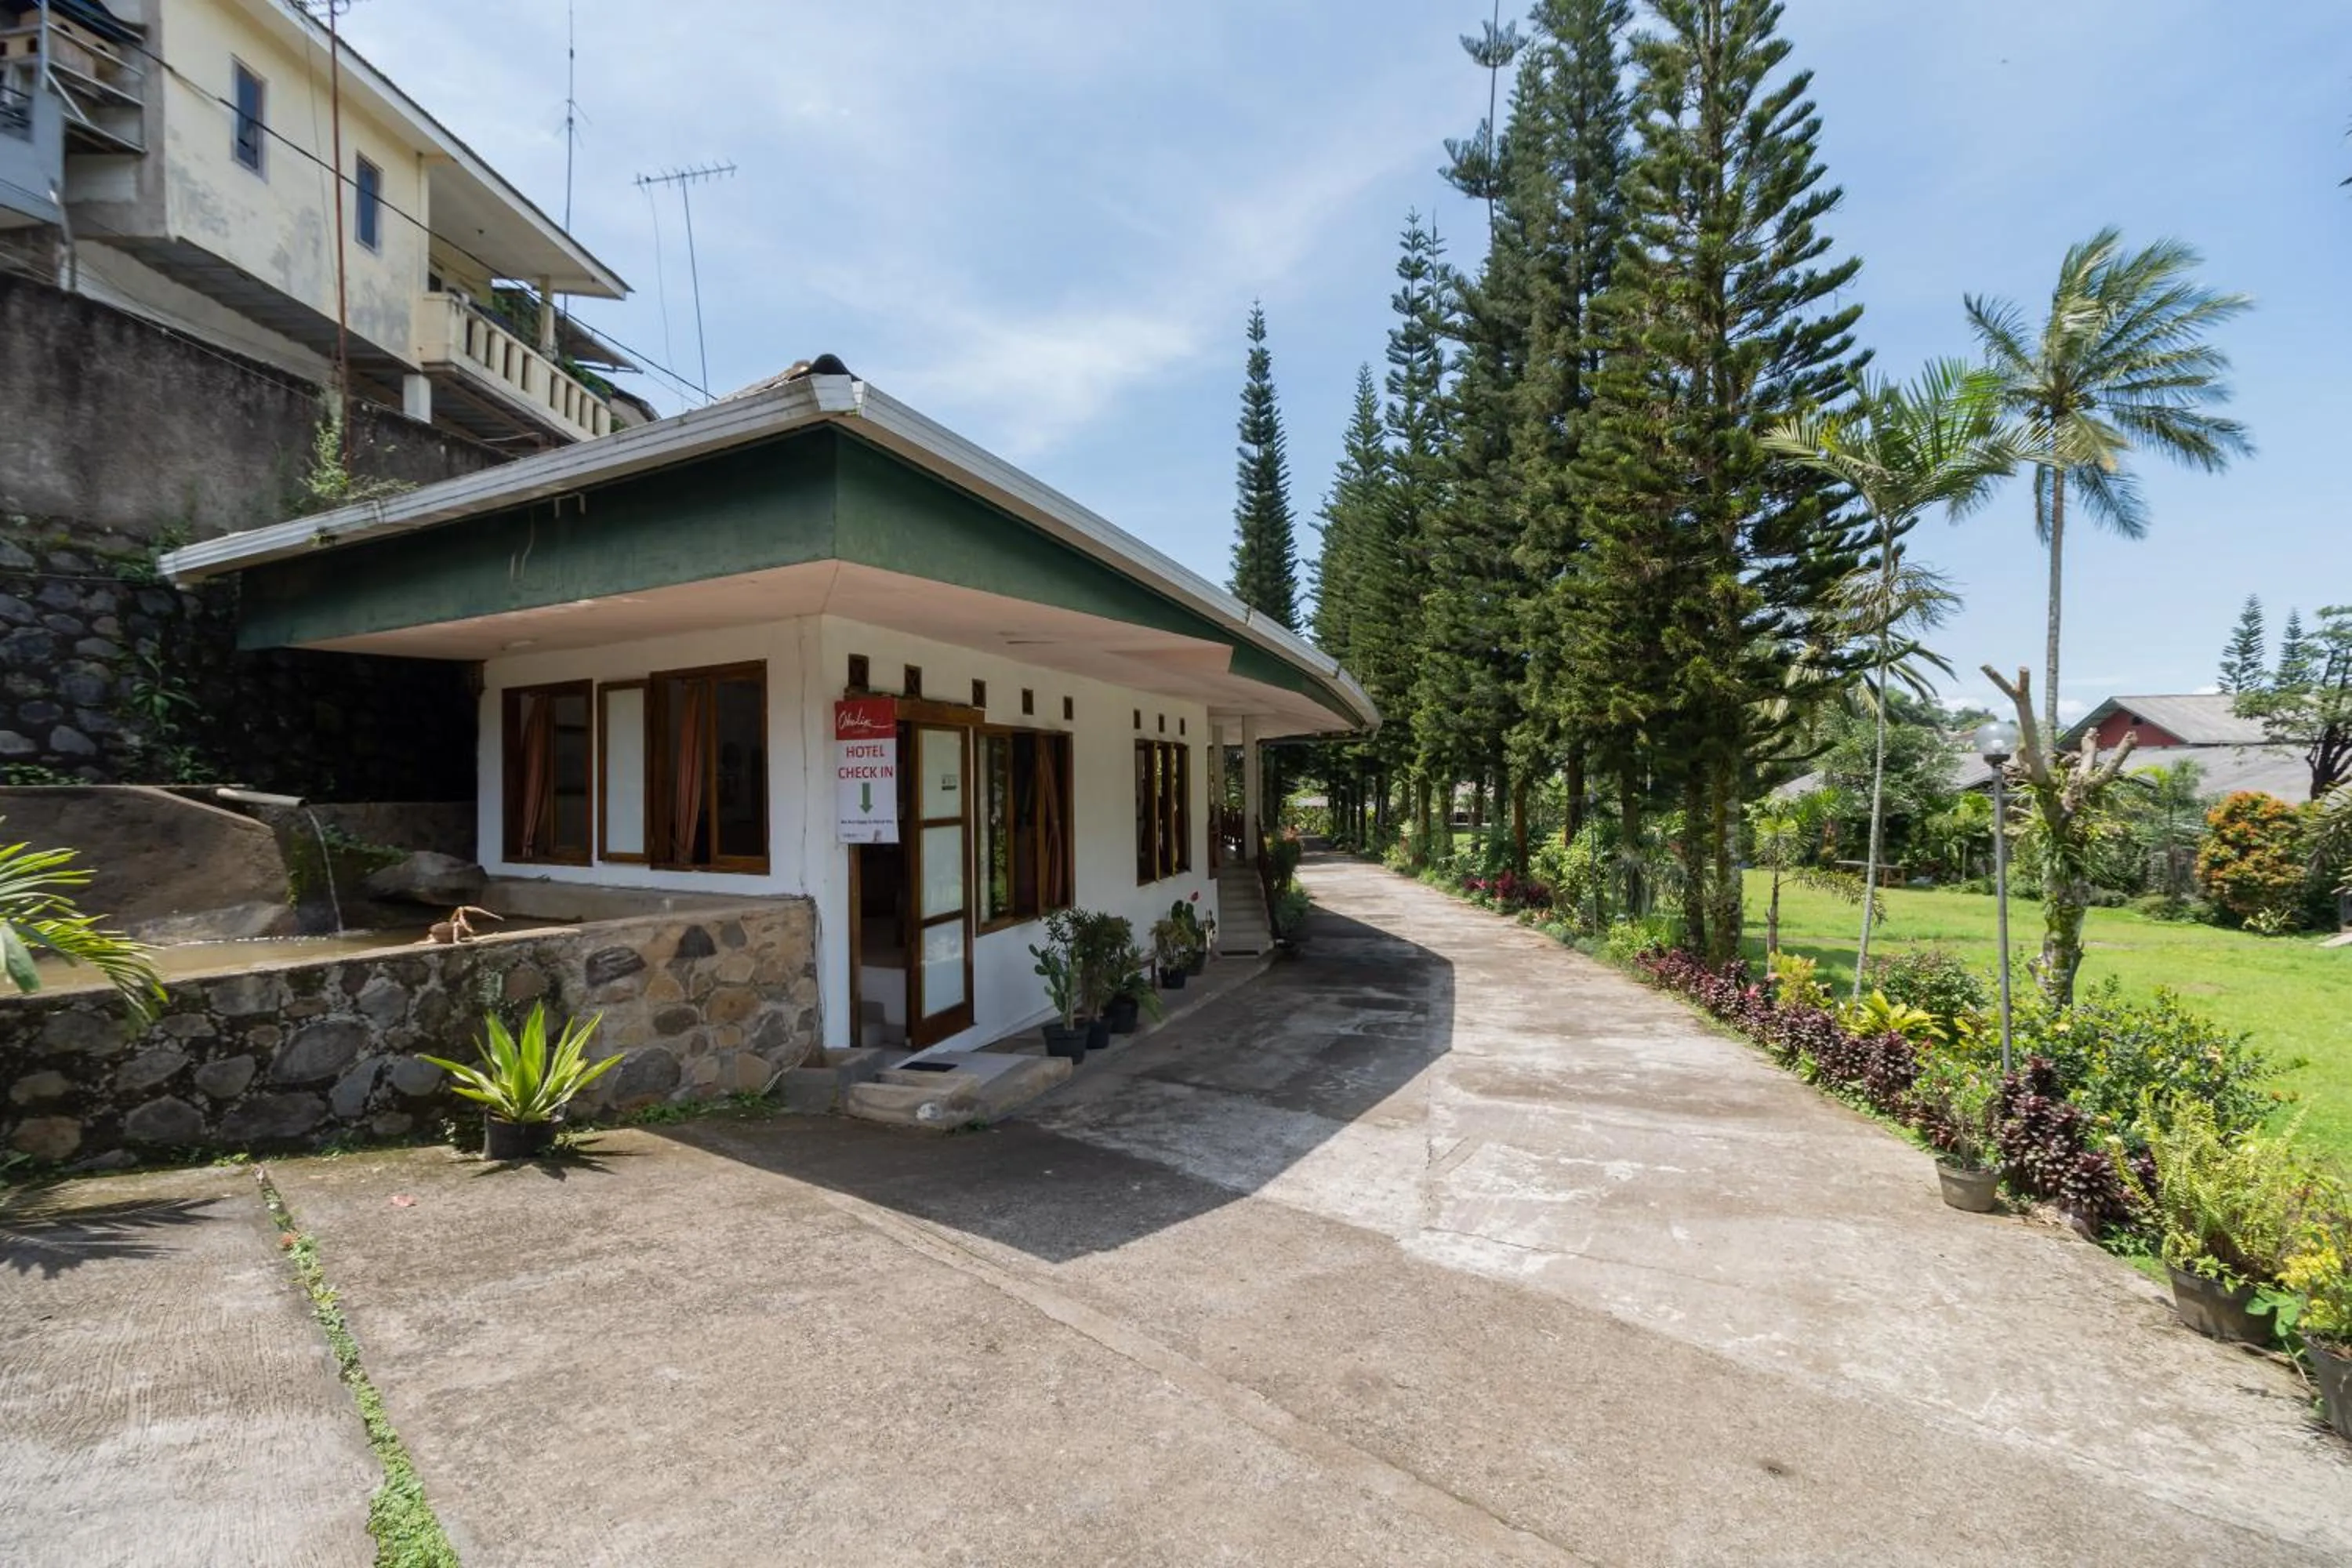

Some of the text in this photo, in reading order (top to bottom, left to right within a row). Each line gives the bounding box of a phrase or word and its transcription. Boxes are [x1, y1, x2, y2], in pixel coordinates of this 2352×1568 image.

[846, 745, 885, 758] HOTEL
[838, 765, 893, 779] CHECK IN
